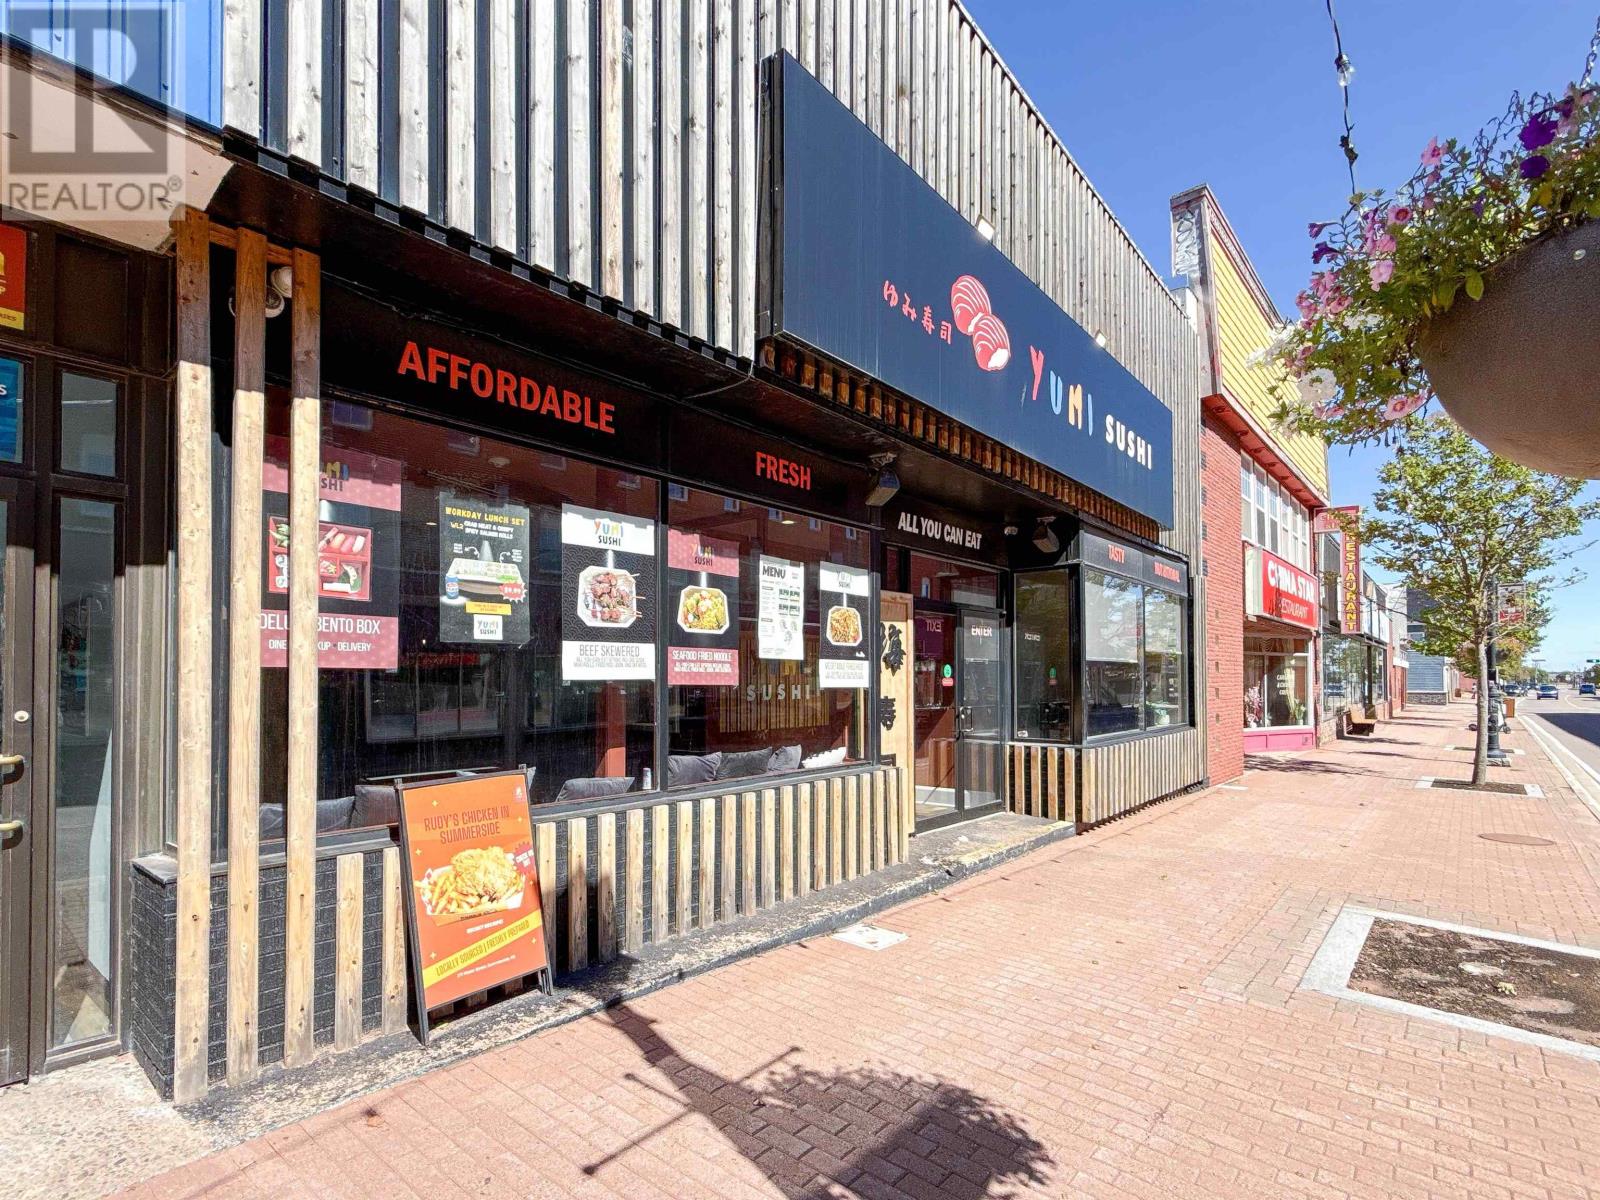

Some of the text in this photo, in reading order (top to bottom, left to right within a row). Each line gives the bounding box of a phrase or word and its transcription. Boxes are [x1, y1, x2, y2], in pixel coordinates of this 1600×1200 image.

[883, 280, 952, 344] ゆみ寿司
[398, 341, 615, 434] AFFORDABLE
[1030, 345, 1152, 470] YUMI SUSHI
[755, 451, 811, 490] FRESH
[320, 477, 344, 491] SHI
[445, 506, 525, 526] WORKDAY LUNCH SET
[594, 517, 623, 538] YUMI
[898, 511, 983, 550] ALL YOU CAN EAT
[598, 535, 621, 547] SUSHI
[694, 556, 713, 567] SUSHI
[1108, 544, 1125, 564] TASTY
[762, 565, 786, 580] MENU
[356, 618, 381, 634] BOX
[971, 624, 993, 637] ENTER
[337, 641, 372, 652] DELIVERY
[579, 644, 640, 657] BEEF SKEWERED
[672, 650, 697, 661] SEAFOOD
[746, 683, 811, 702] SUSHI
[424, 805, 510, 832] RUDY'S CHICKEN IN
[440, 821, 501, 845] SUMMERSIDE
[435, 956, 460, 977] LOCALLY
